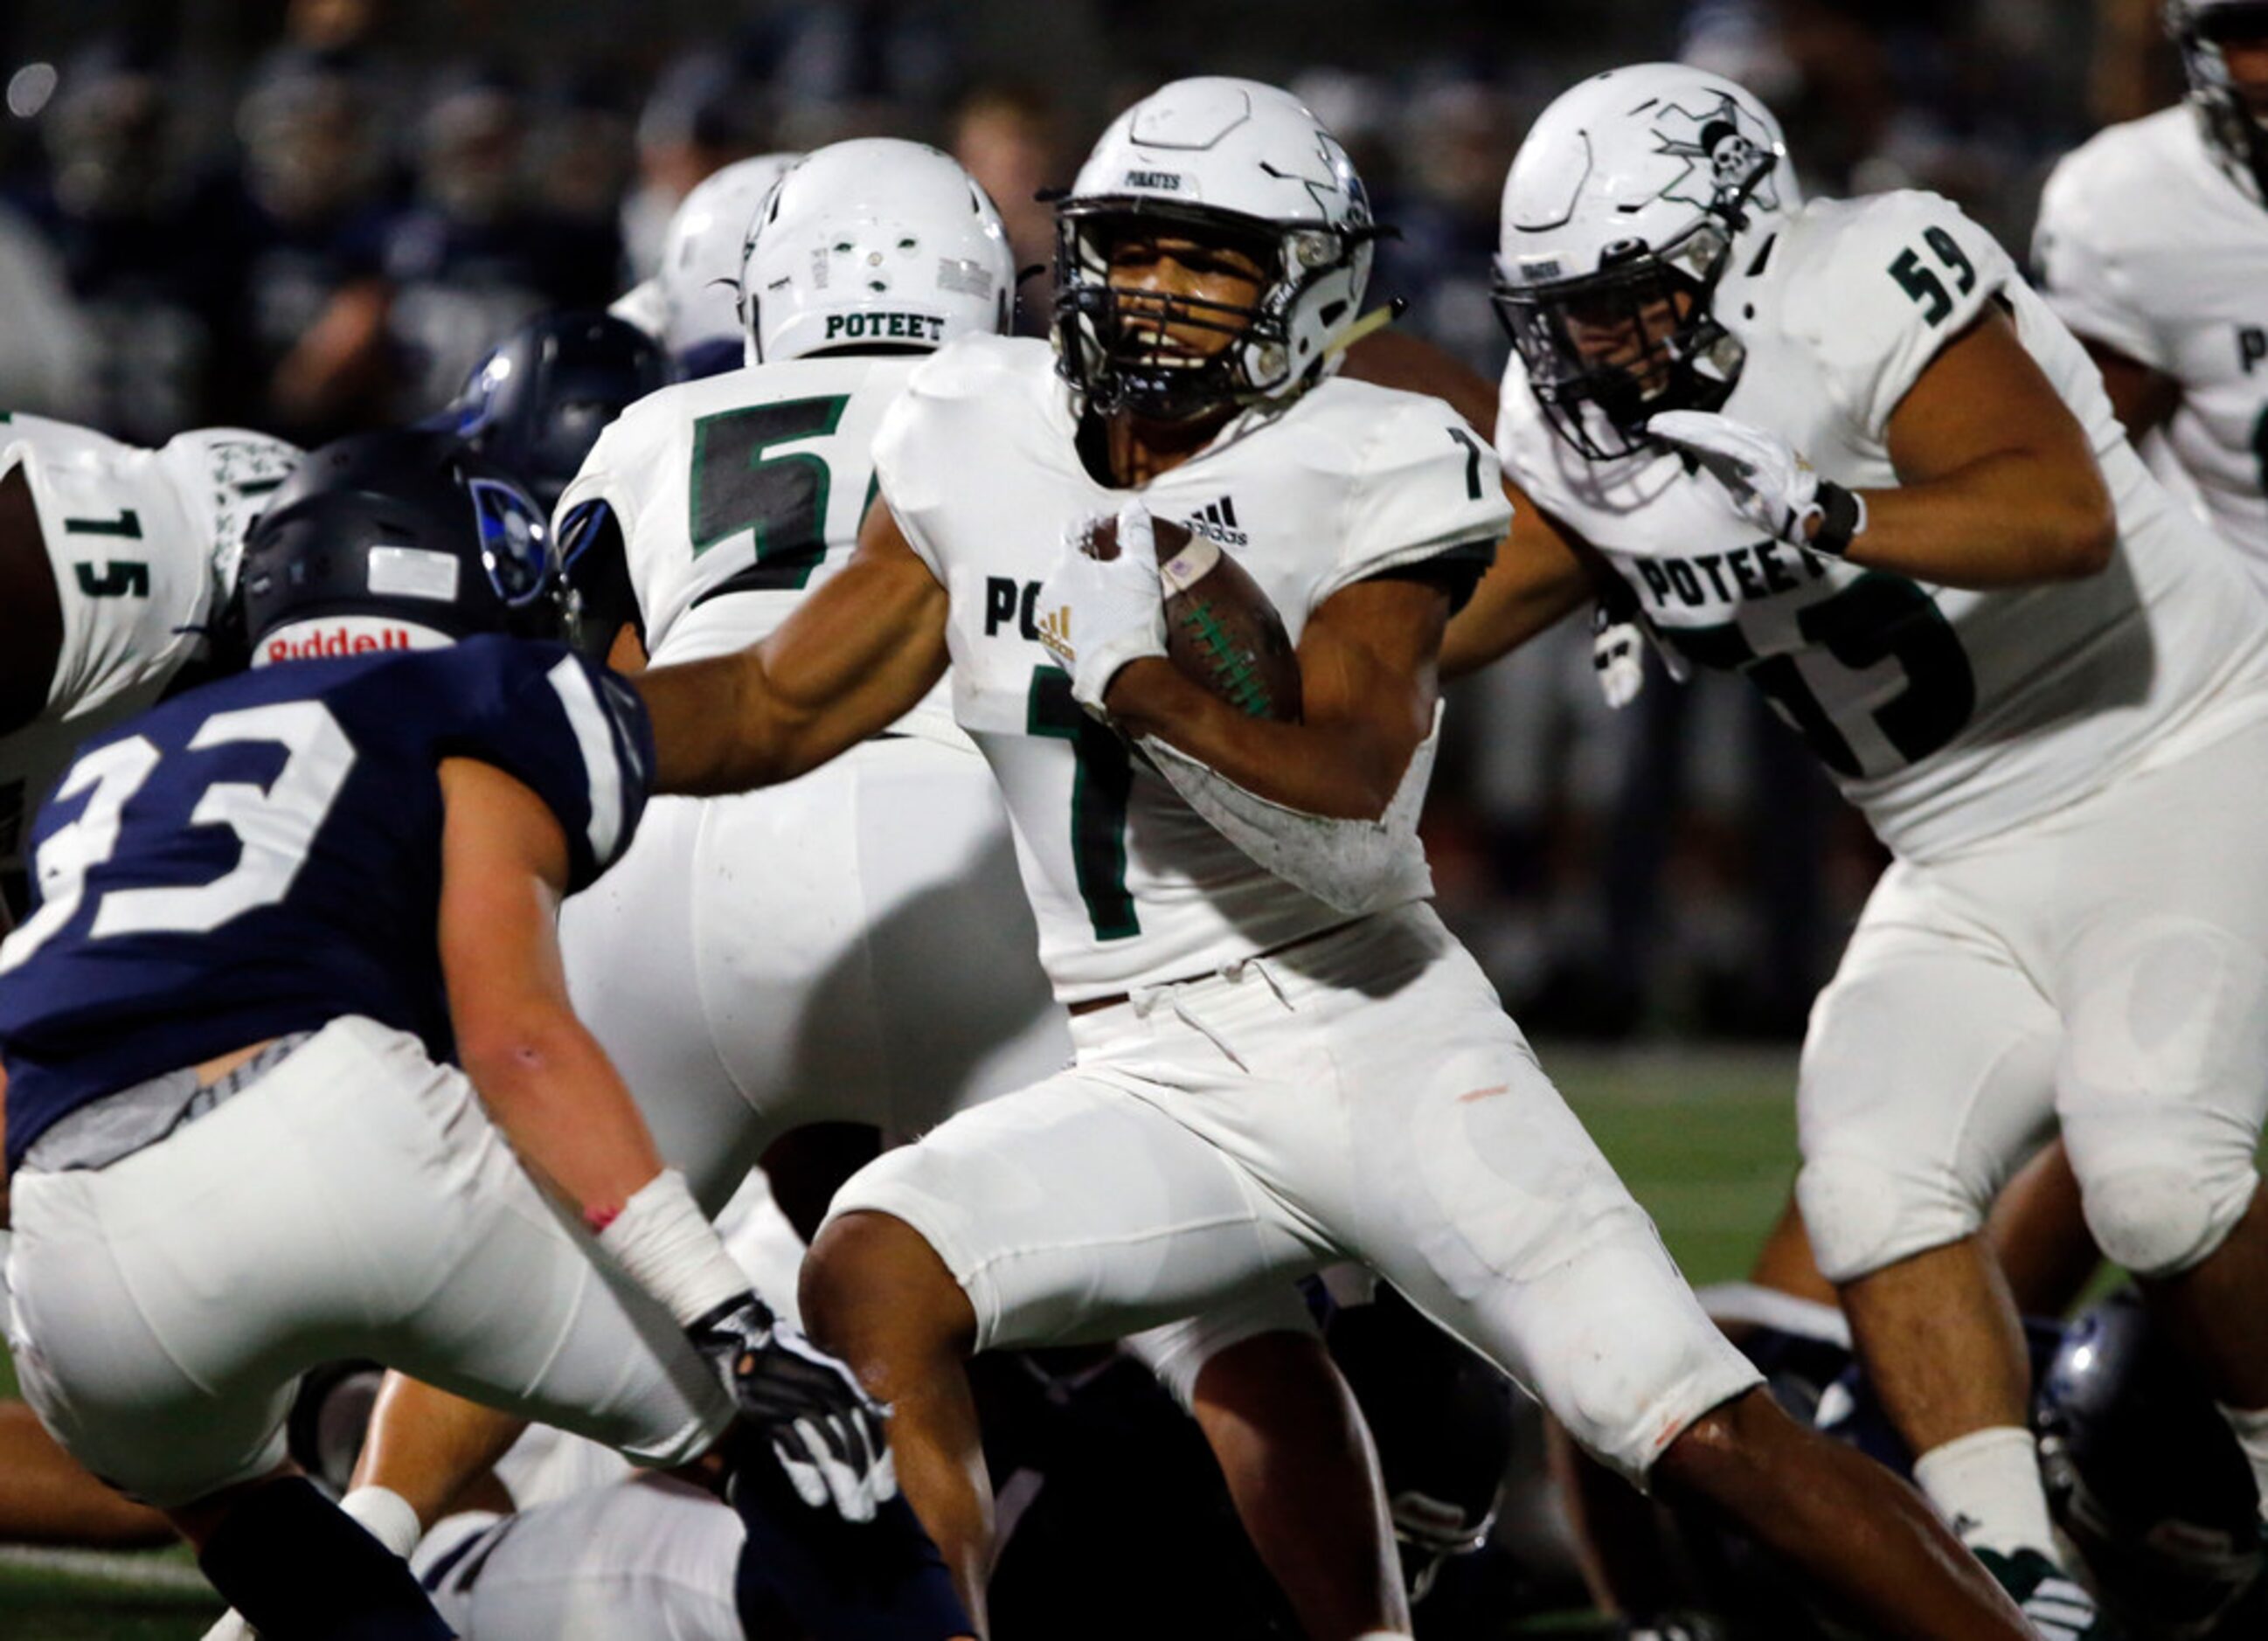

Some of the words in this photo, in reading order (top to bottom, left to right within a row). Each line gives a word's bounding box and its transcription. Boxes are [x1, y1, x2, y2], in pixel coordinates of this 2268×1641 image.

[1887, 225, 1975, 329] 59
[825, 312, 944, 341] POTEET
[64, 508, 149, 599] 15
[0, 699, 359, 976] 33
